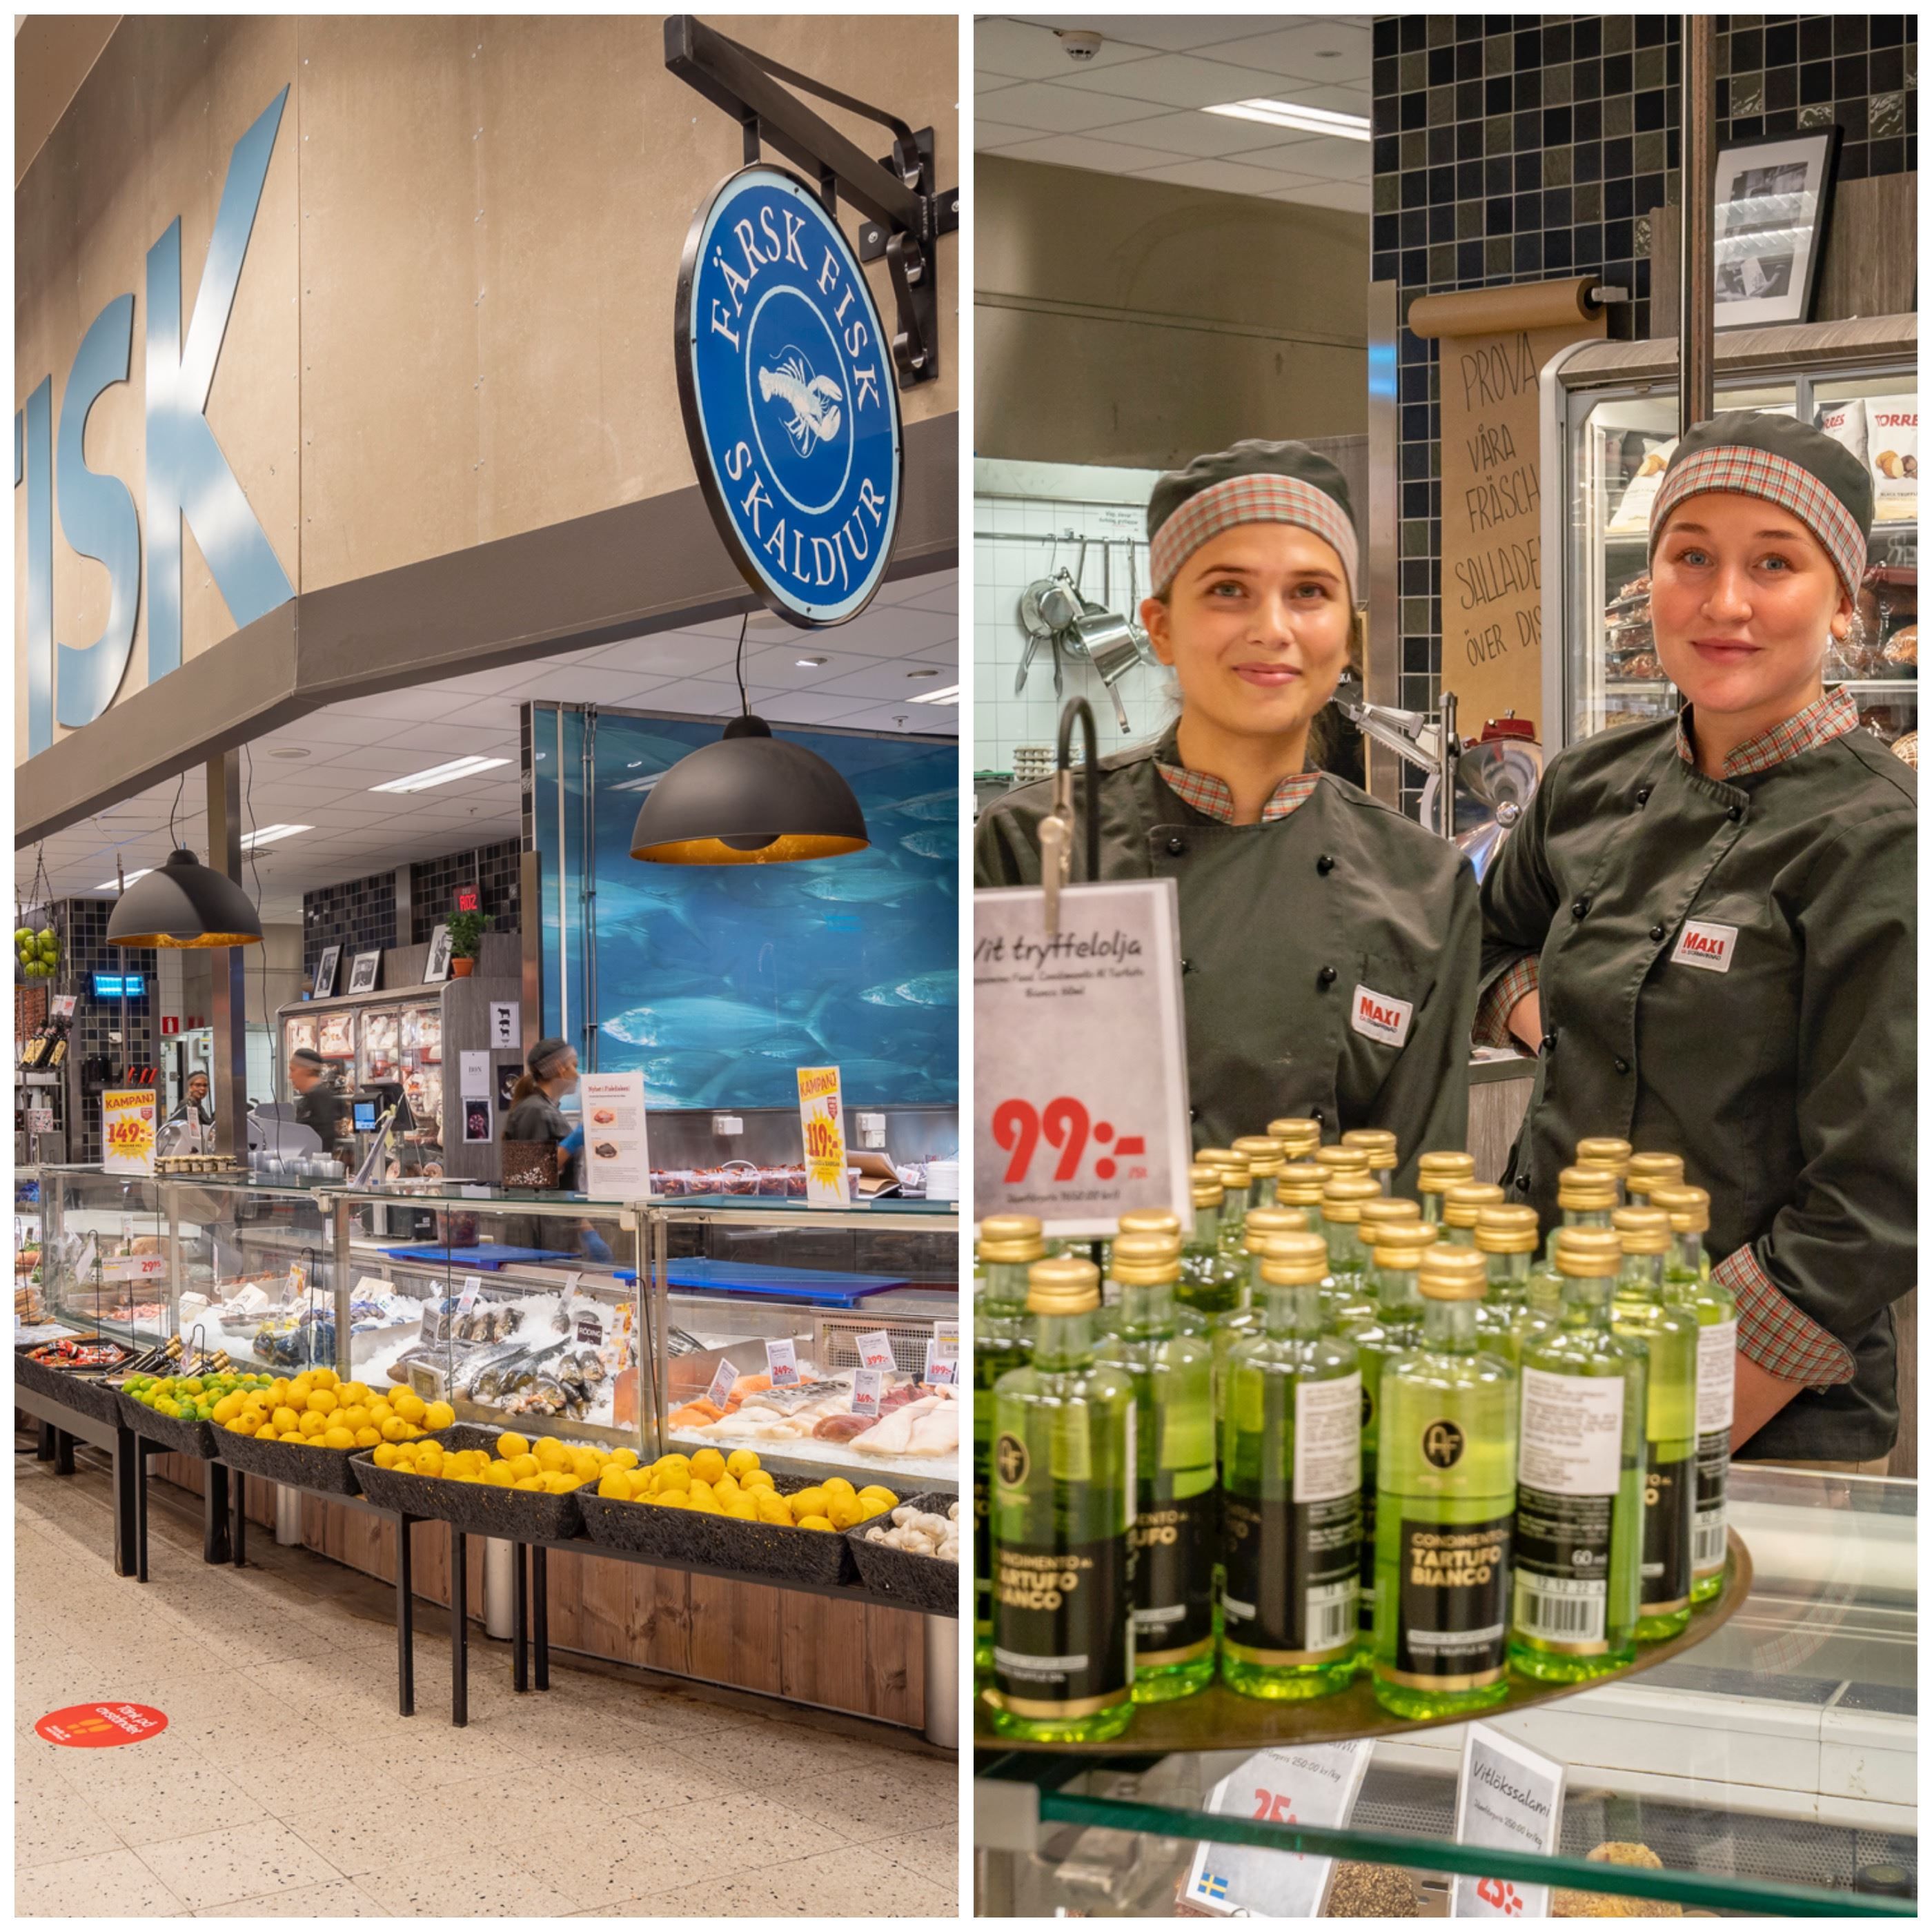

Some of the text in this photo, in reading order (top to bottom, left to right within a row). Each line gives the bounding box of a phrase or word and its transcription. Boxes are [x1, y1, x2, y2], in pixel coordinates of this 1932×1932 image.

[711, 205, 881, 413] FÄRSK FISK
[1460, 331, 1539, 413] PROVA
[14, 83, 297, 760] ISK
[1466, 423, 1517, 474] VÅRA
[724, 441, 887, 591] SKALDJUR
[1465, 462, 1540, 534] FRÄSCH
[1455, 535, 1541, 611] SALLADE
[1464, 622, 1508, 667] ÖVER
[1012, 929, 1142, 969] tryffelolja
[1684, 931, 1725, 956] MAXI
[1359, 996, 1401, 1027] MAXI
[106, 1093, 155, 1109] KAMPANJ
[800, 1072, 837, 1096] KAMPANJ
[108, 1123, 152, 1143] 149:-
[807, 1123, 838, 1158] 119:-
[992, 1096, 1145, 1185] 99:-
[1412, 1529, 1503, 1548] CONDIMENTO
[1412, 1545, 1502, 1567] TARTUFO
[1571, 1549, 1593, 1567] 60
[1411, 1566, 1491, 1586] BIANCO
[1472, 1760, 1552, 1818] Vitlökssalami
